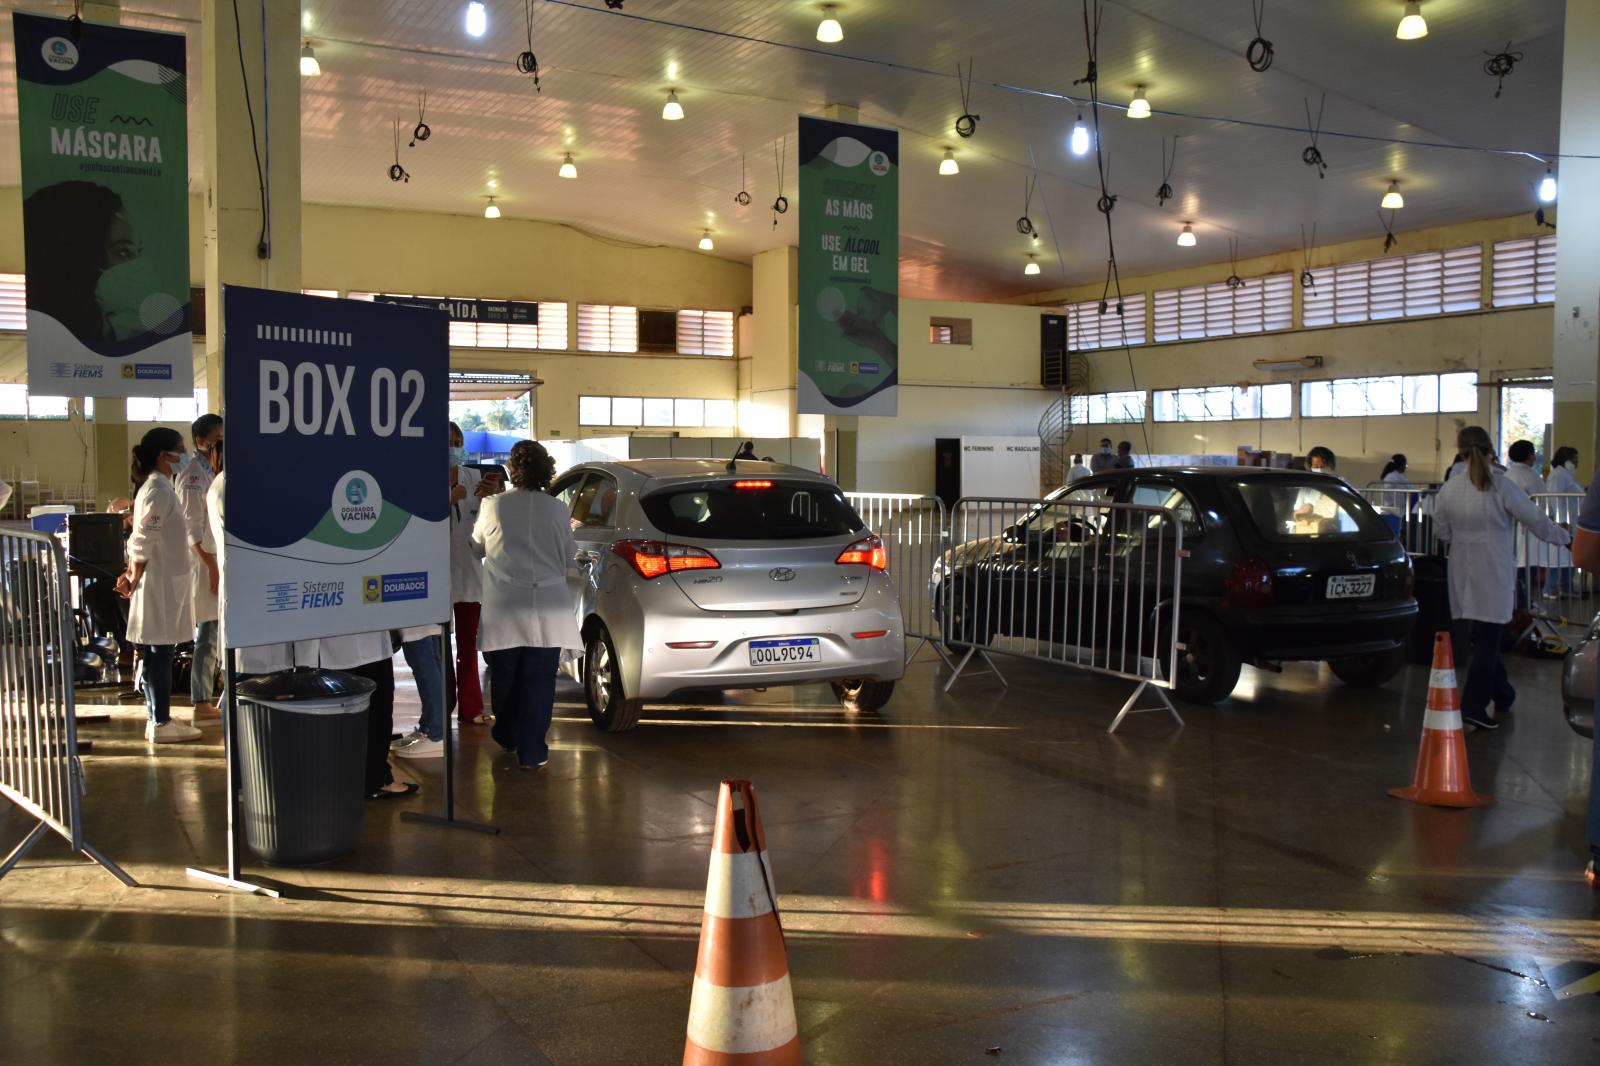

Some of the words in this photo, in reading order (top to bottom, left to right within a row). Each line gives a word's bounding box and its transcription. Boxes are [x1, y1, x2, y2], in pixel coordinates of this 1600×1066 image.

[51, 92, 100, 124] USE
[50, 126, 163, 163] MÁSCARA
[825, 198, 839, 216] AS
[842, 199, 873, 220] MÃOS
[821, 234, 841, 252] USE
[832, 255, 848, 271] EM
[851, 256, 870, 273] GEL
[73, 369, 104, 379] FIEMS
[259, 358, 356, 437] BOX
[370, 367, 426, 438] 02
[341, 512, 377, 521] VACINA
[302, 580, 344, 594] Sistema
[383, 581, 426, 593] DOURADOS
[301, 591, 344, 609] FIEMS
